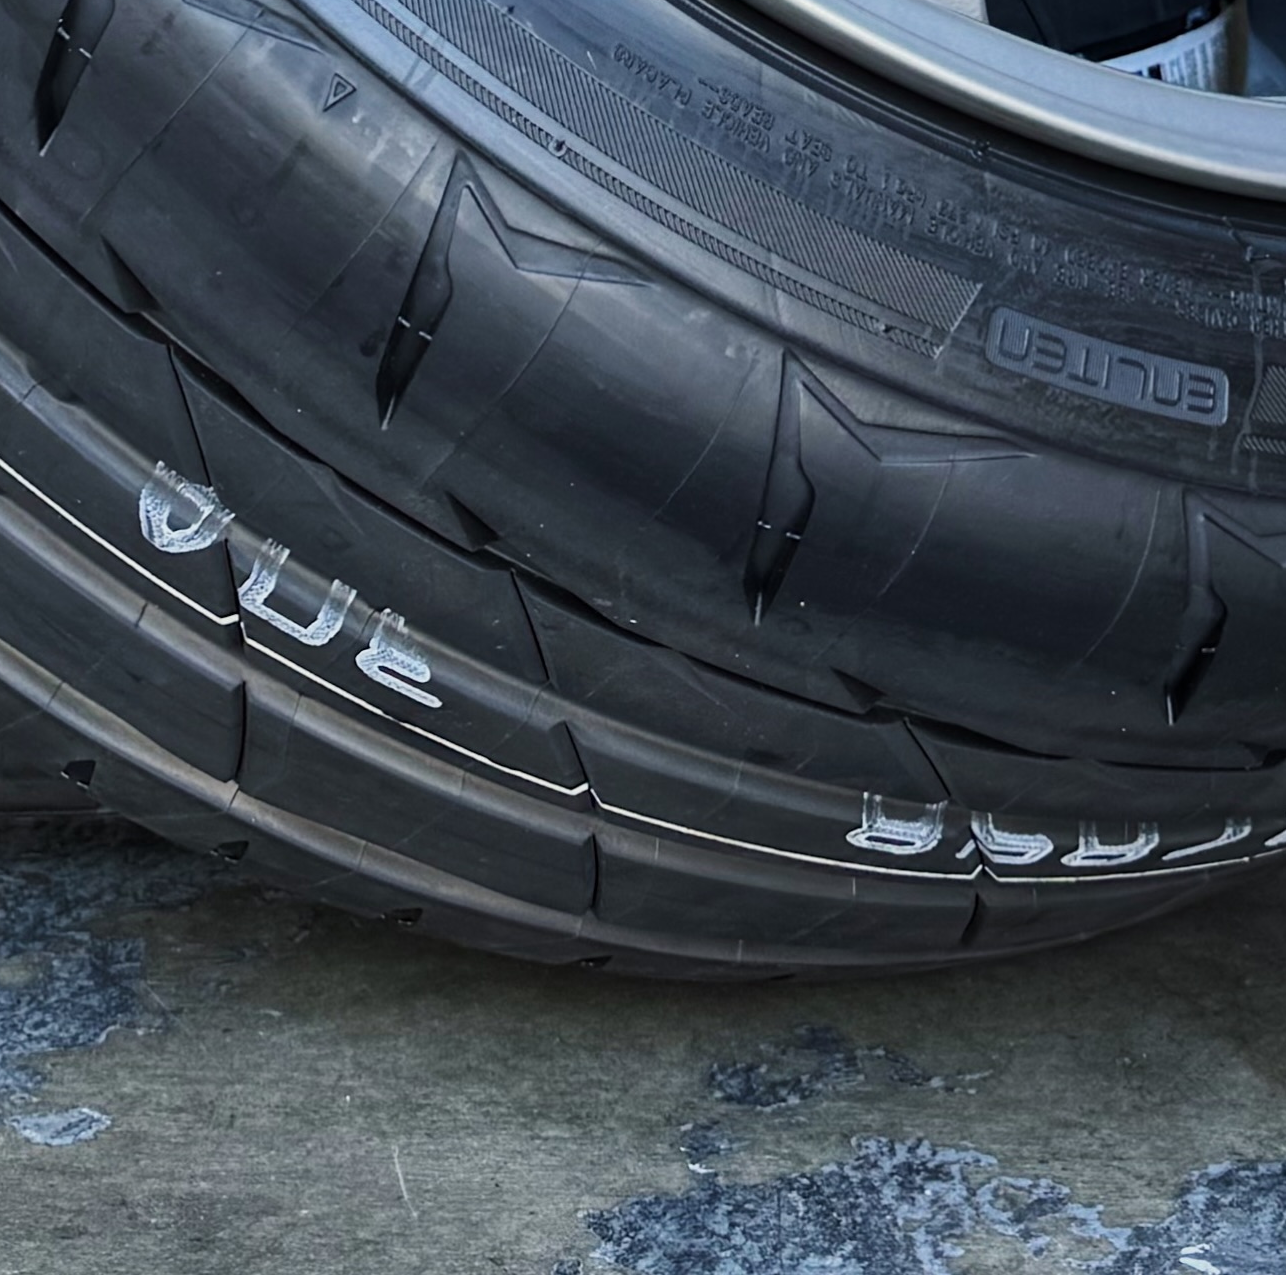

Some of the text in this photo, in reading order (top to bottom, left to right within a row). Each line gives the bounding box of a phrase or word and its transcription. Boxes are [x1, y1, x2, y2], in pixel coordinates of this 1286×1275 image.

[608, 40, 693, 110] PLACARD
[699, 97, 774, 154] VEHICLE
[784, 122, 835, 163] SEAT
[780, 145, 819, 179] AND
